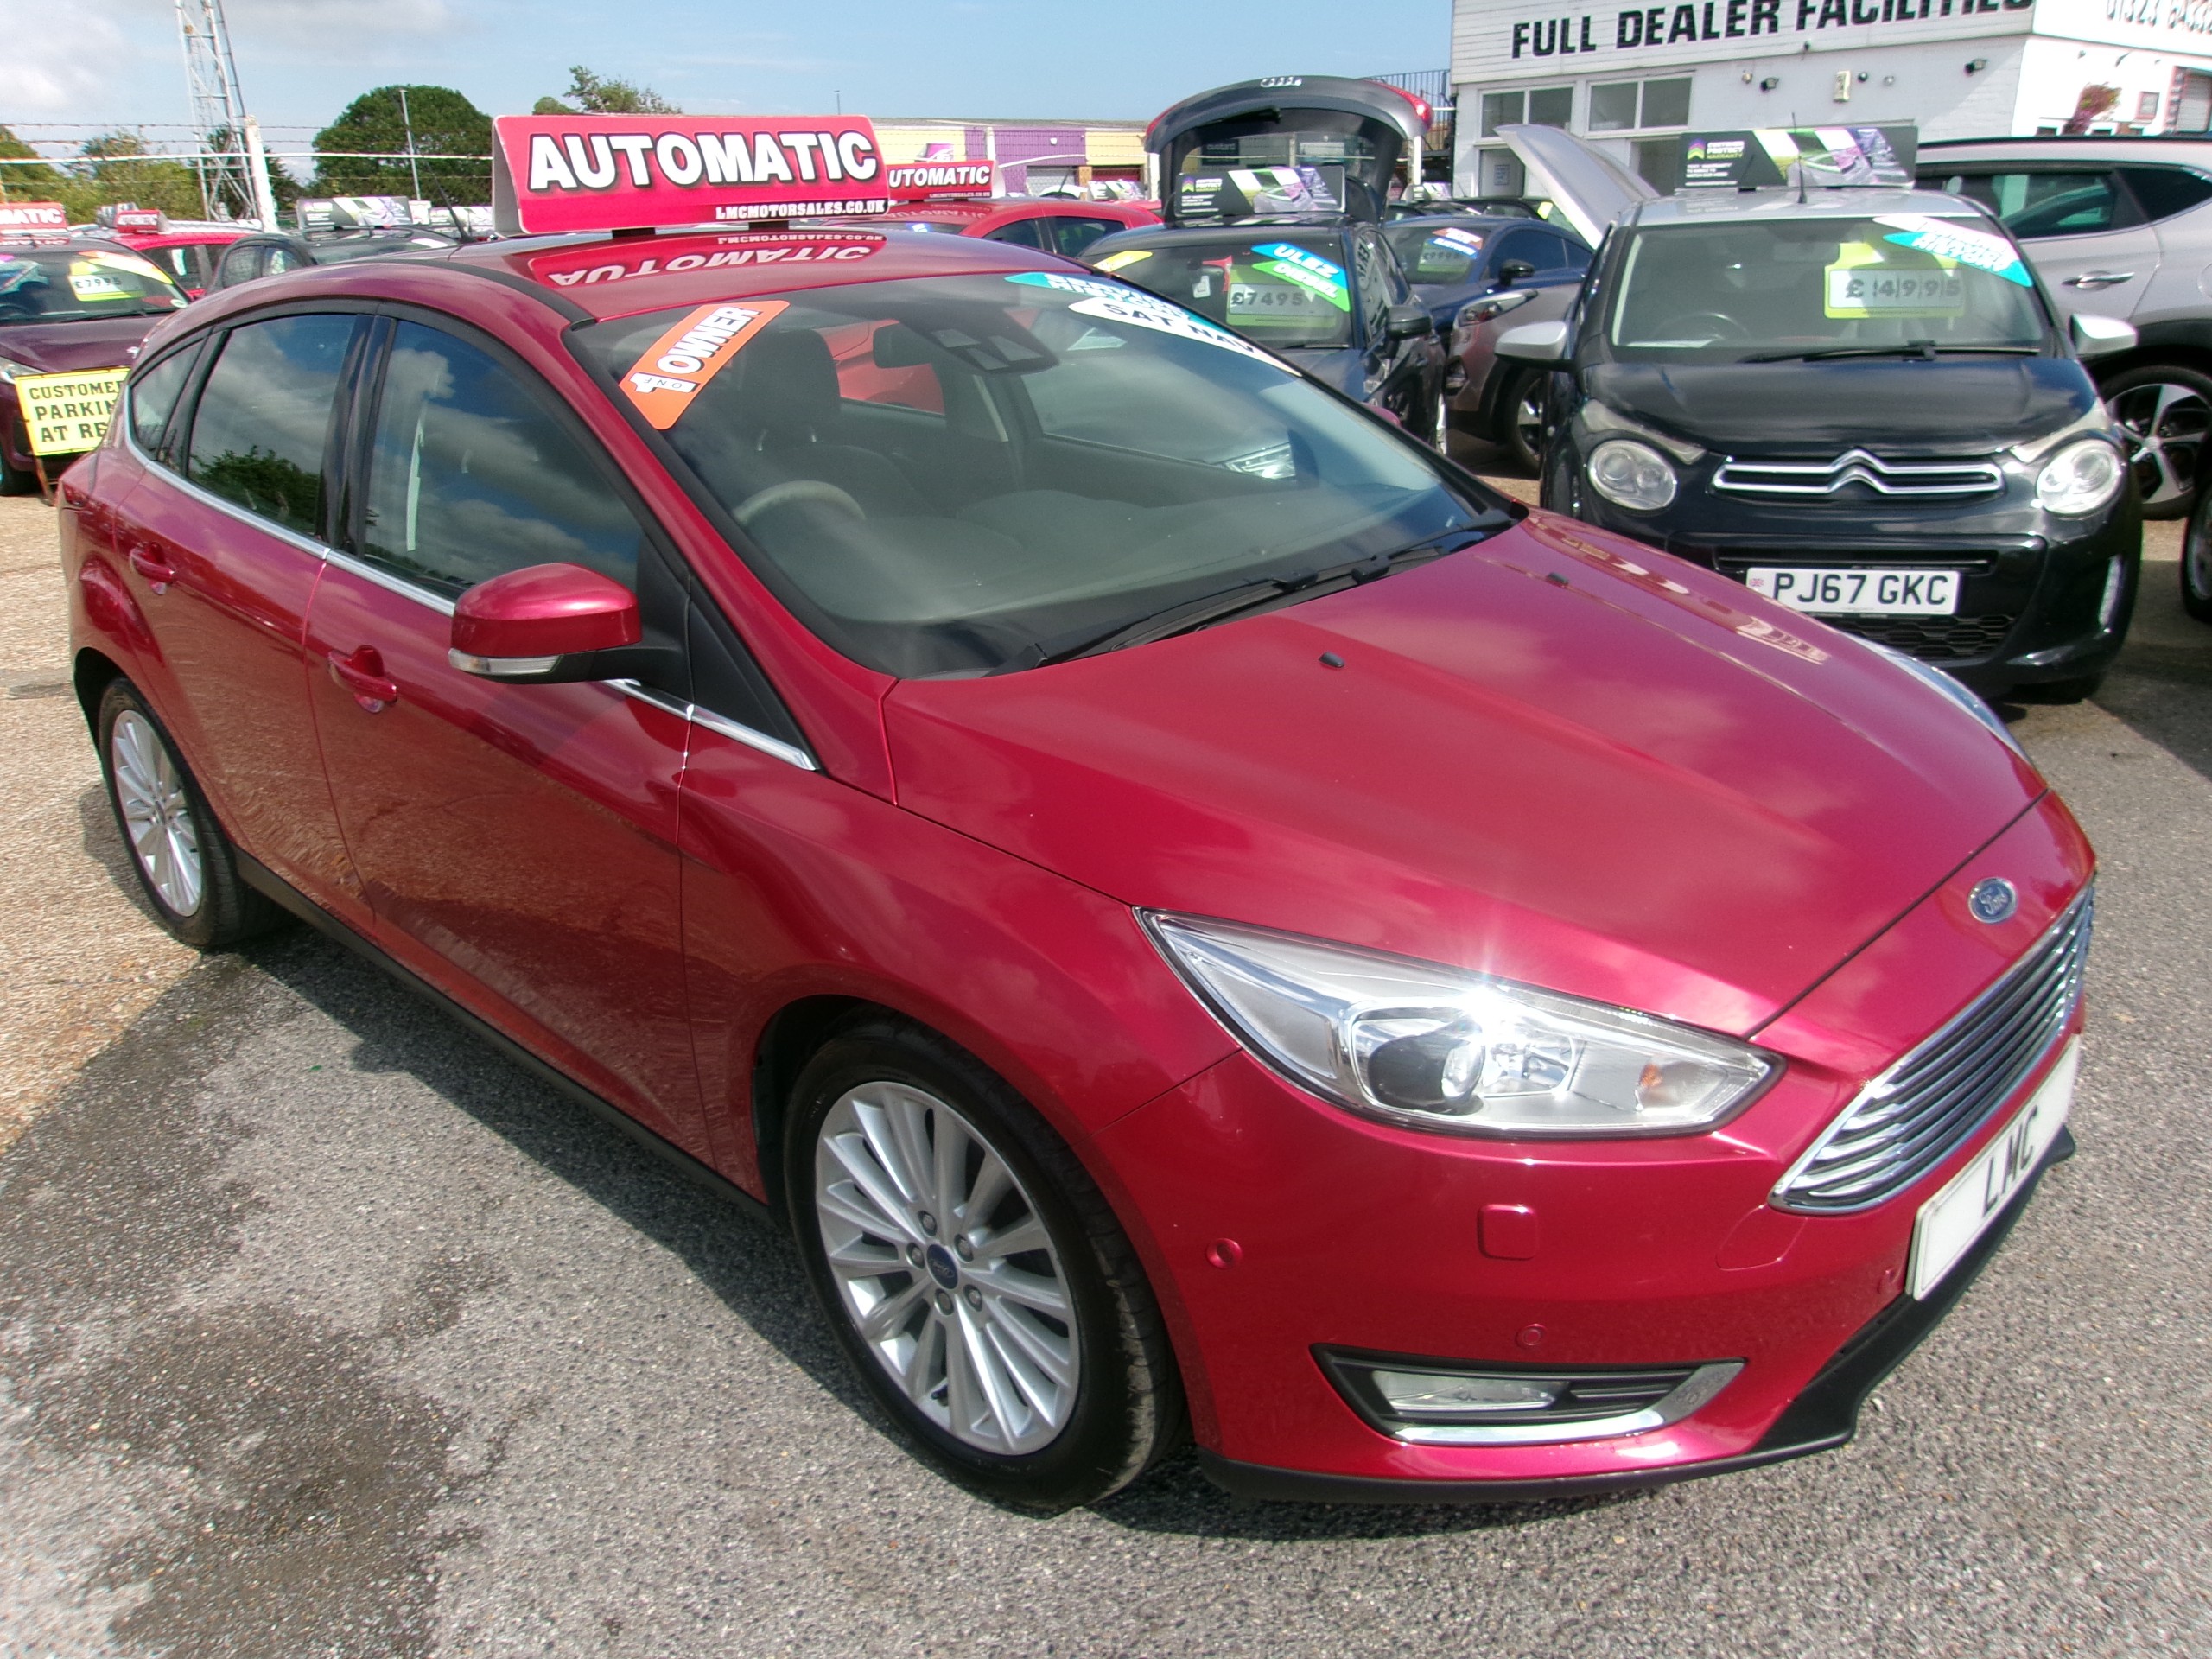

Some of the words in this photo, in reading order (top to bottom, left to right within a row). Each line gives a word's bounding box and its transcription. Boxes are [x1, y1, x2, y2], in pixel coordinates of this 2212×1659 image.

[1512, 16, 1597, 59] FULL
[1616, 0, 1780, 49] DEALER
[529, 131, 877, 190] AUTOMATIC
[715, 200, 887, 219] LMCMOTORSALES.CO.UK
[1273, 245, 1339, 278] ULEZ
[1230, 291, 1304, 306] £7495
[657, 306, 761, 374] OWNER
[1103, 302, 1175, 327] SAT
[1192, 326, 1256, 353] NAV
[41, 425, 67, 442] AT
[1773, 572, 1867, 604] PJ67
[1878, 575, 1948, 605] GKC
[1982, 1105, 2039, 1217] LMC
